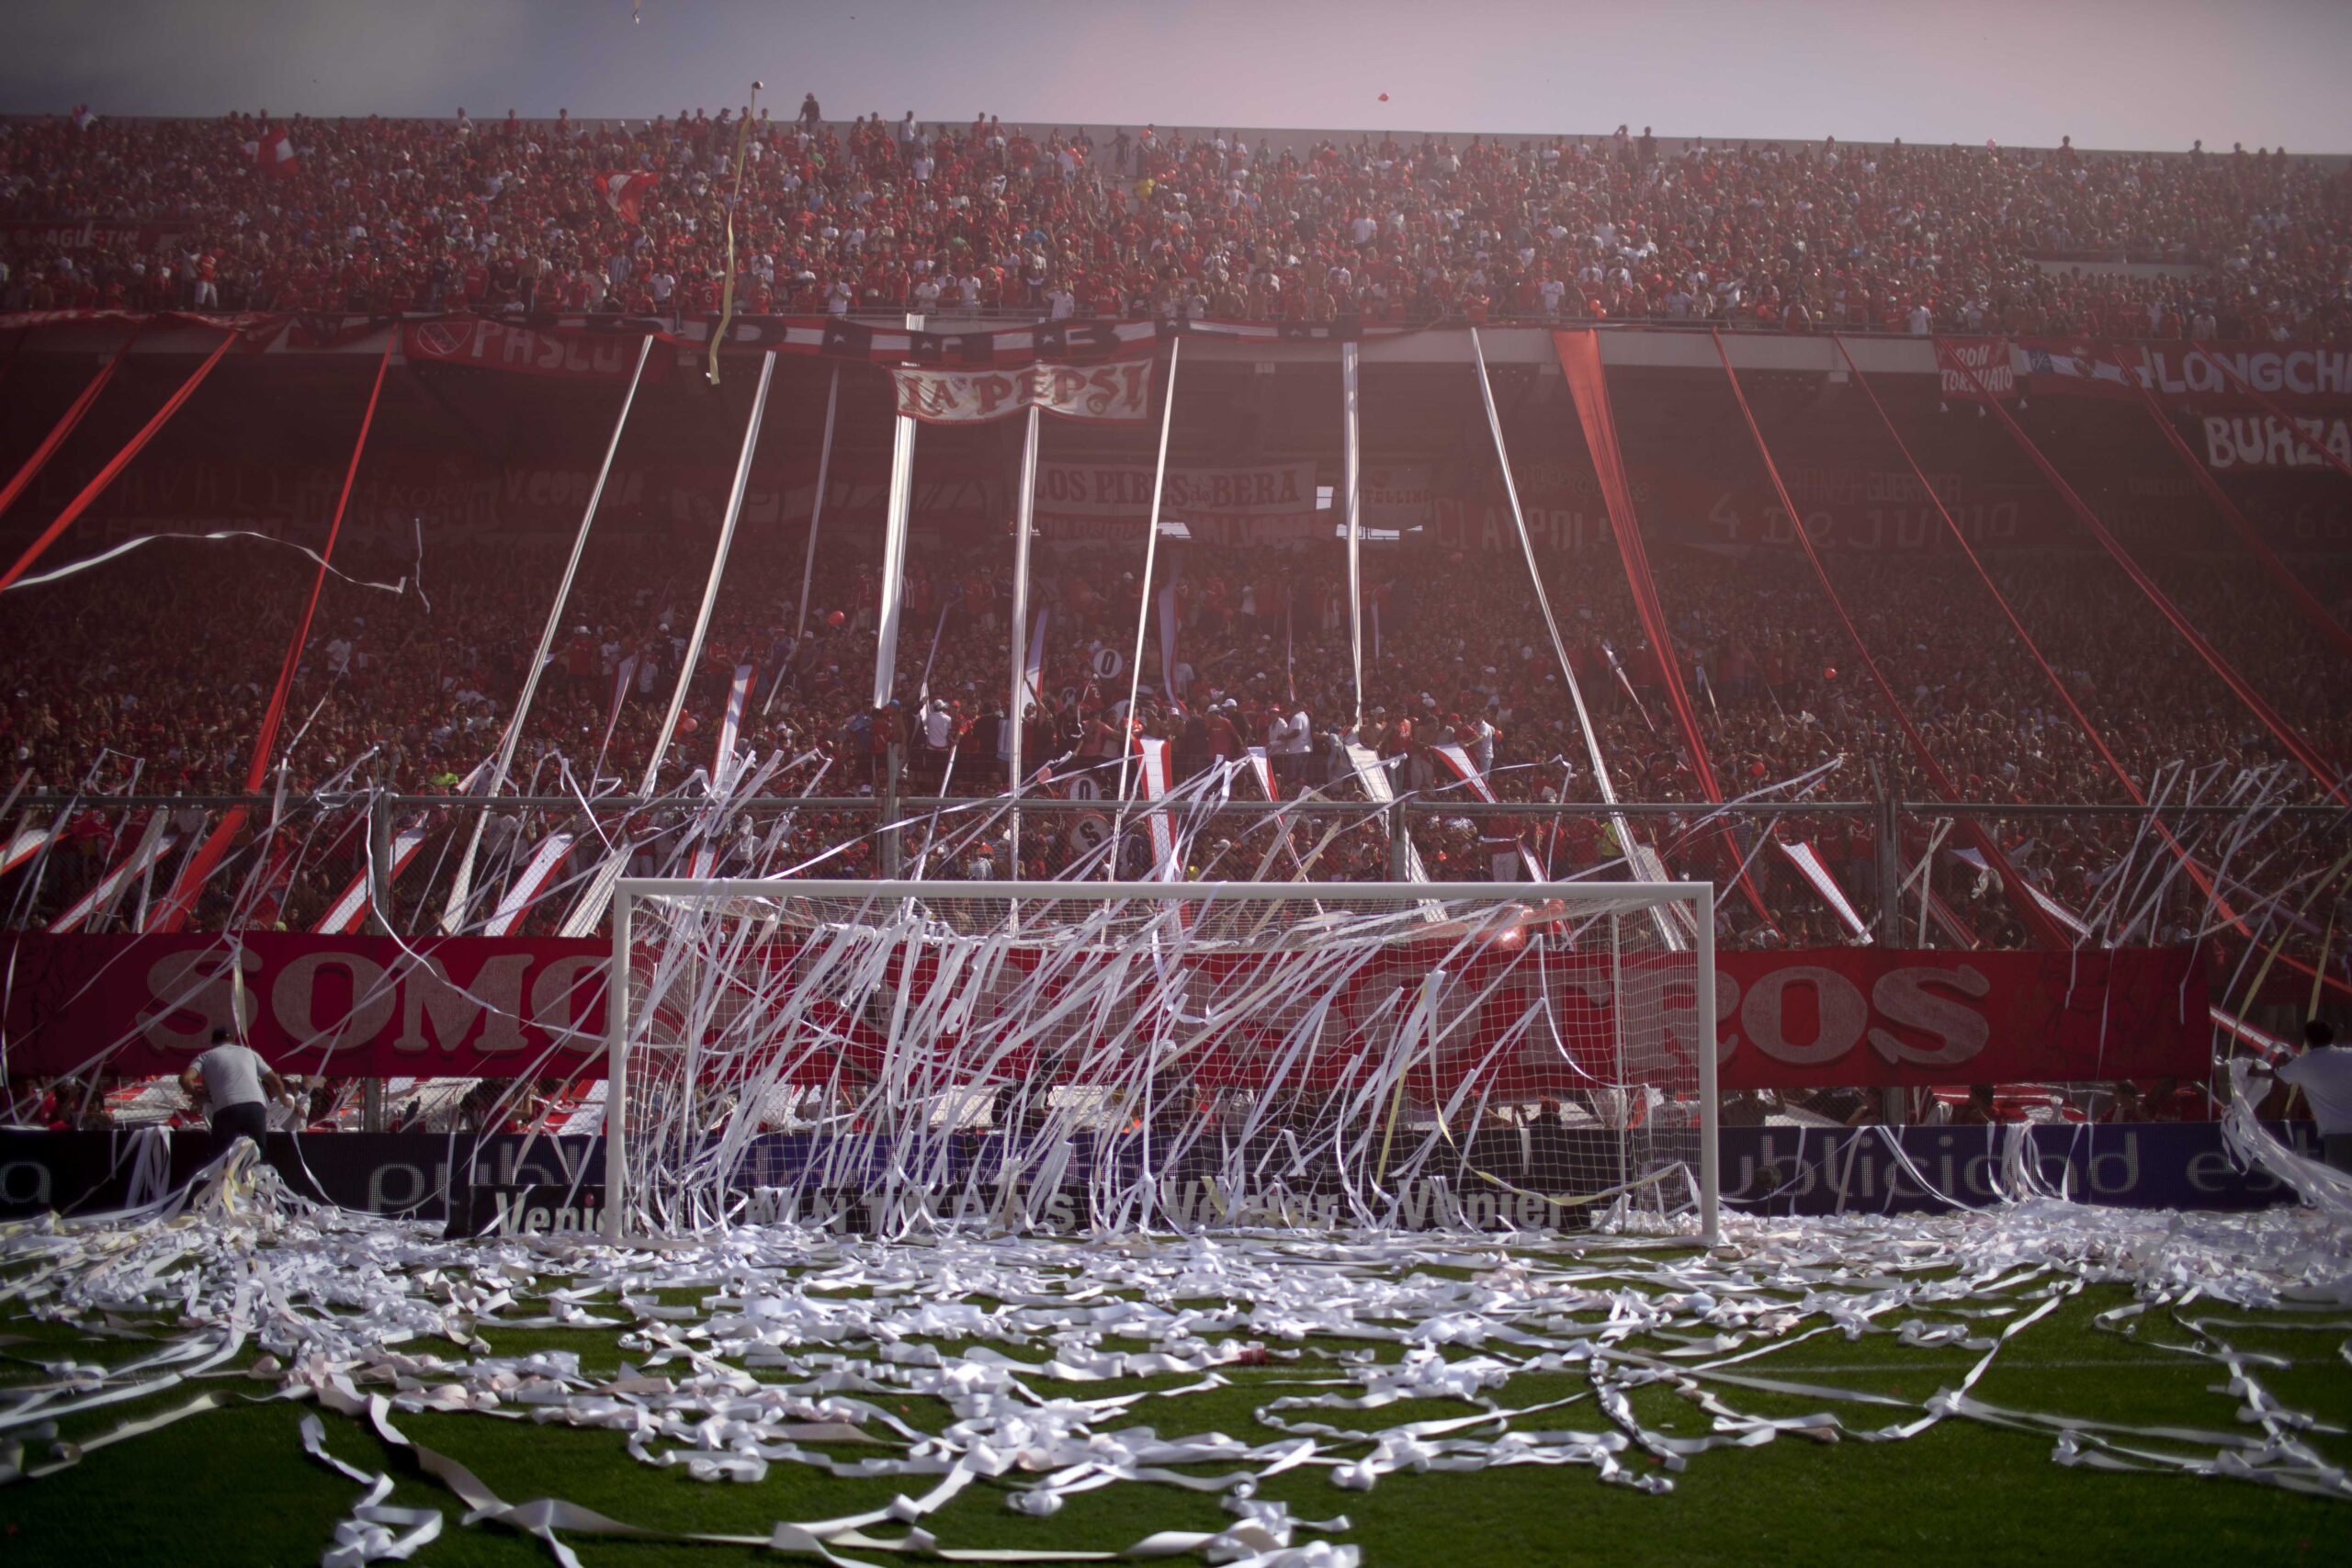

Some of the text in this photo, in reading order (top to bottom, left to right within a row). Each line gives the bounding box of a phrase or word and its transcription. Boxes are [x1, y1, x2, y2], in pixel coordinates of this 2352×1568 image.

[968, 364, 1147, 416] PEPSI
[2150, 349, 2352, 394] LONGCH
[1208, 469, 1298, 508] BERA
[492, 1190, 643, 1236] Veni
